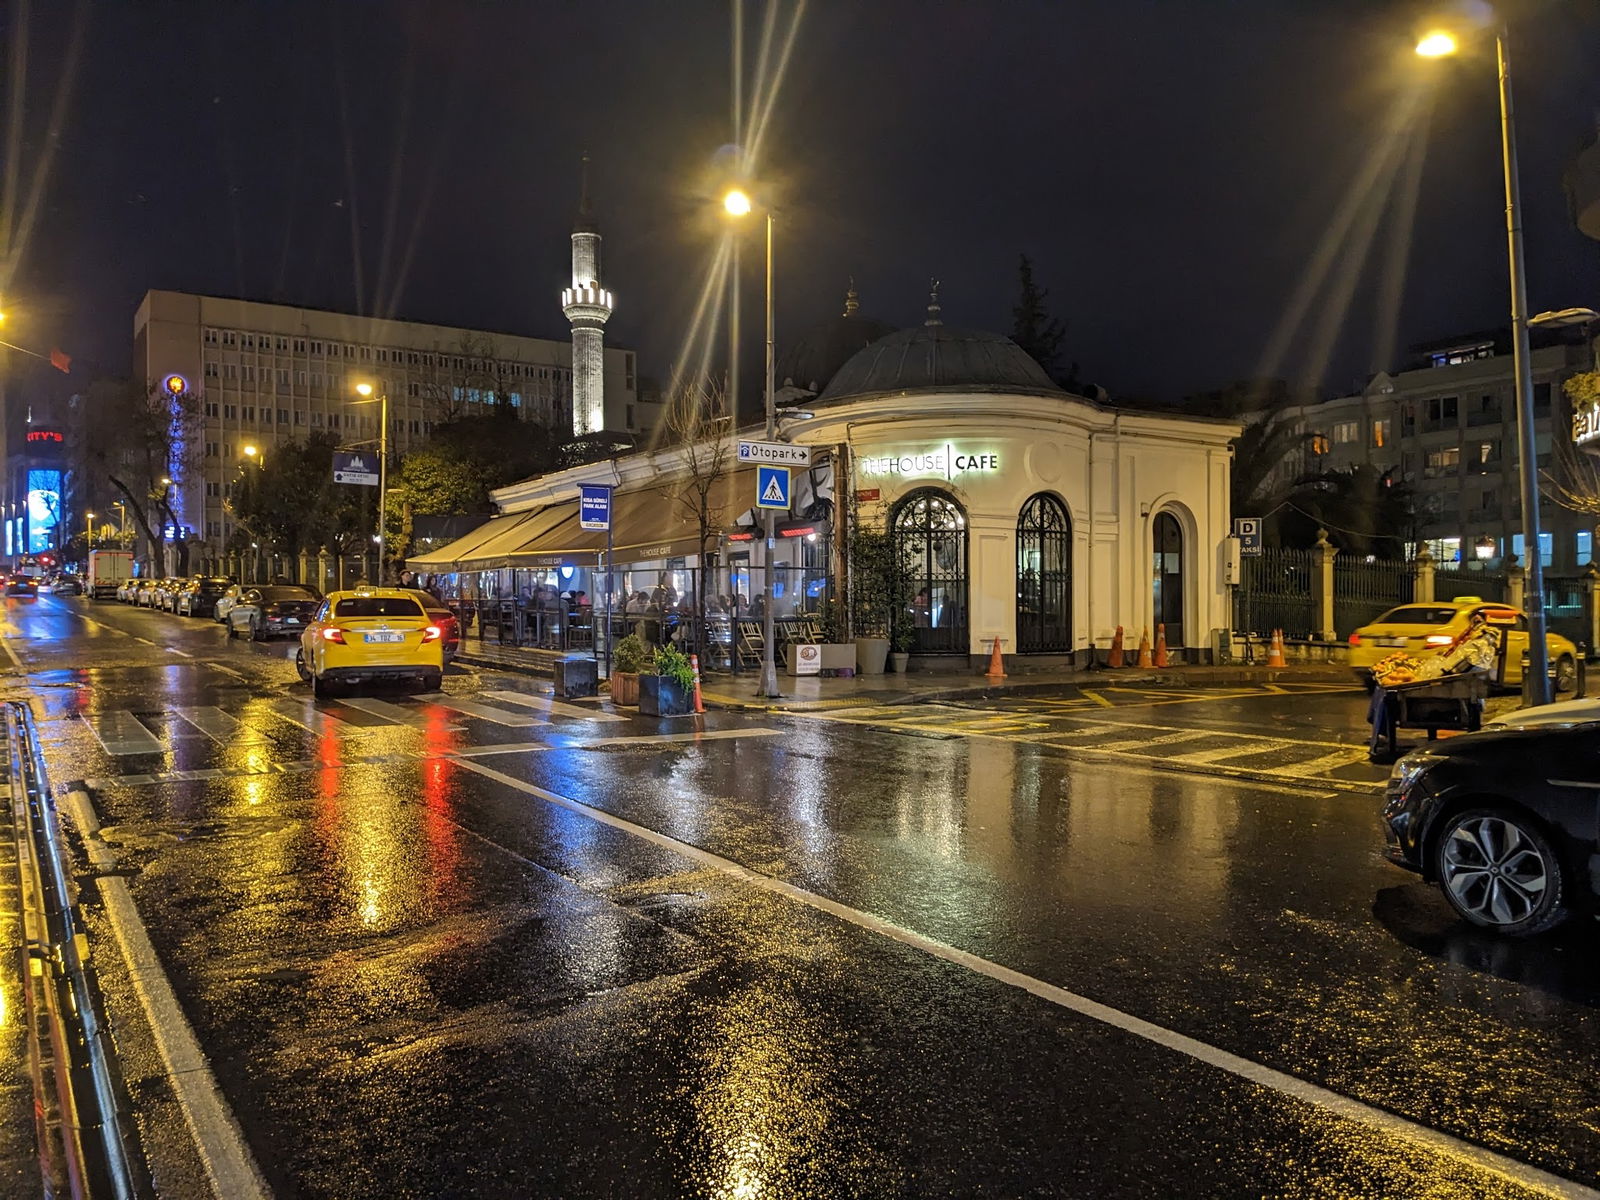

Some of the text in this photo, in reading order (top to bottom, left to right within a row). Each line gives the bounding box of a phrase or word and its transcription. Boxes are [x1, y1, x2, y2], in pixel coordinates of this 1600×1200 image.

[751, 445, 797, 460] Otopark
[955, 455, 998, 470] CAFE
[1243, 523, 1253, 533] D
[1245, 537, 1252, 545] 5
[1240, 545, 1260, 553] AKSİ
